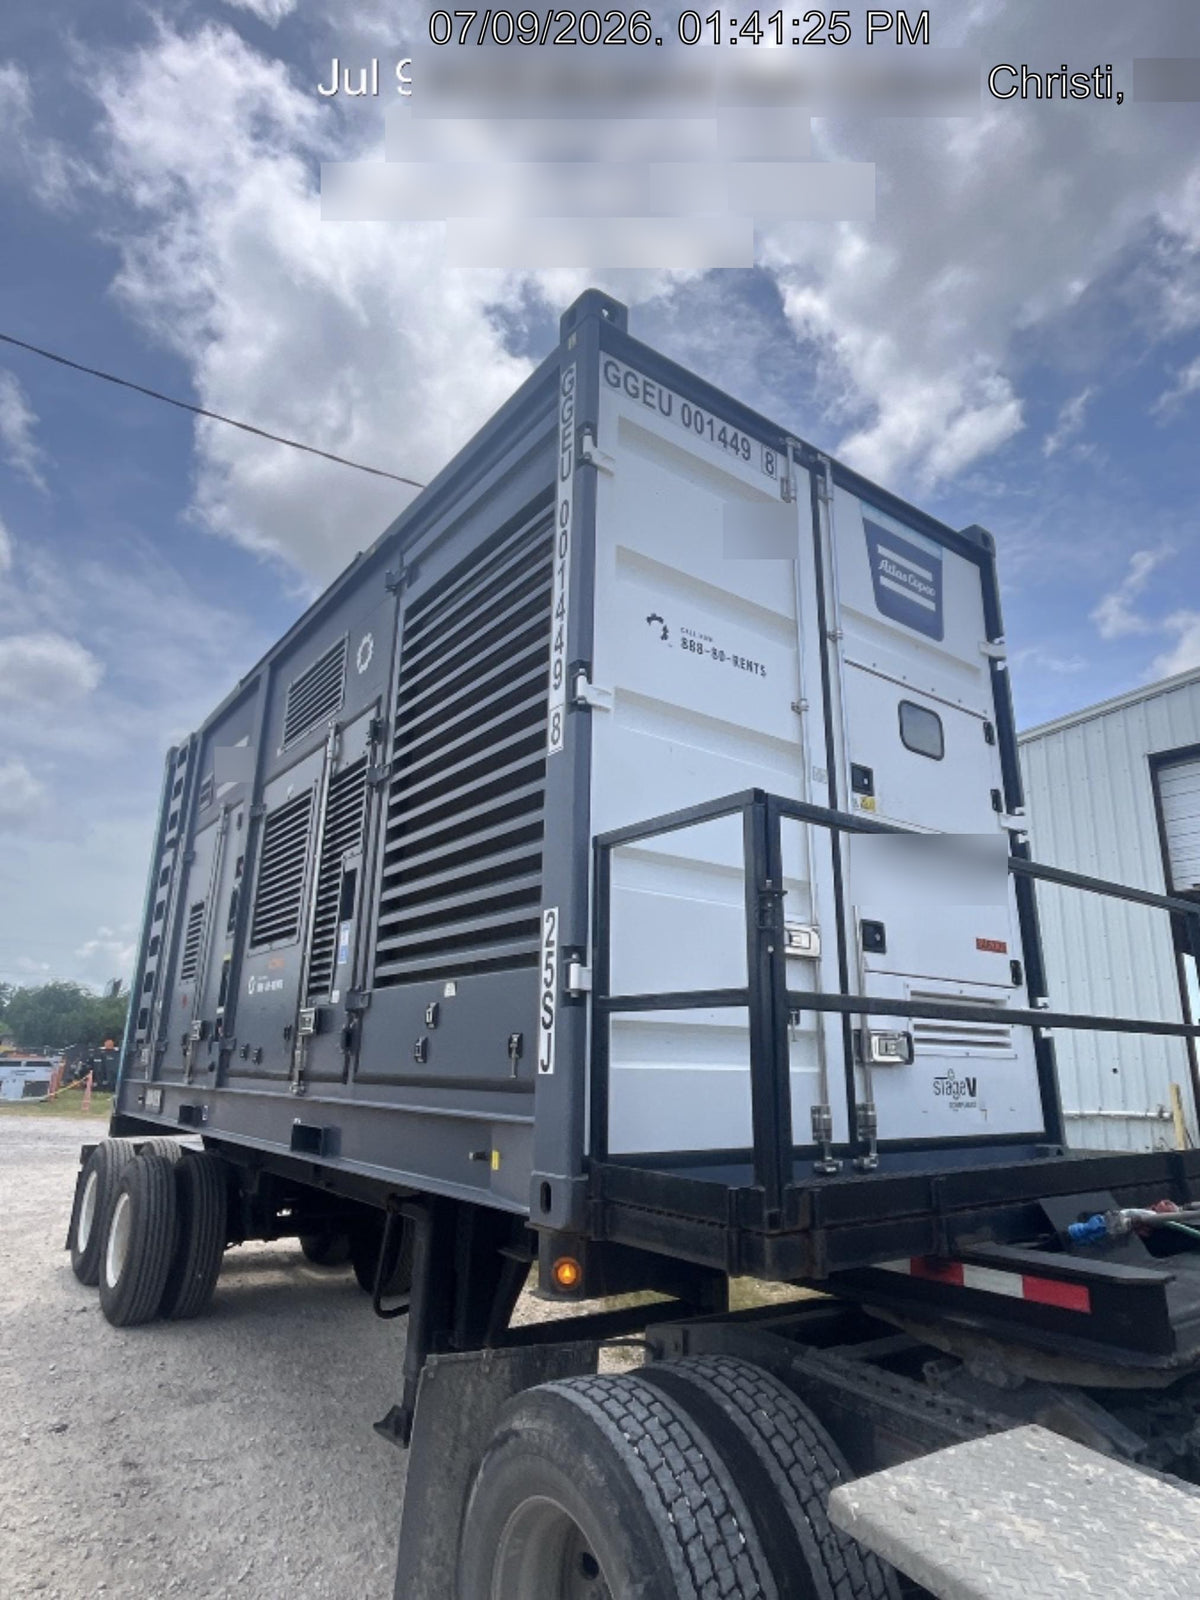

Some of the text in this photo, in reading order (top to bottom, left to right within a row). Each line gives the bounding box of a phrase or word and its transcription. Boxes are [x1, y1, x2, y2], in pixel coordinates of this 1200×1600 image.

[560, 368, 576, 483] GGEU
[603, 359, 775, 476] GGEU 001449 8
[553, 499, 570, 691] 001449
[878, 560, 936, 596] Atlas Copco
[539, 911, 556, 1073] 25SJ
